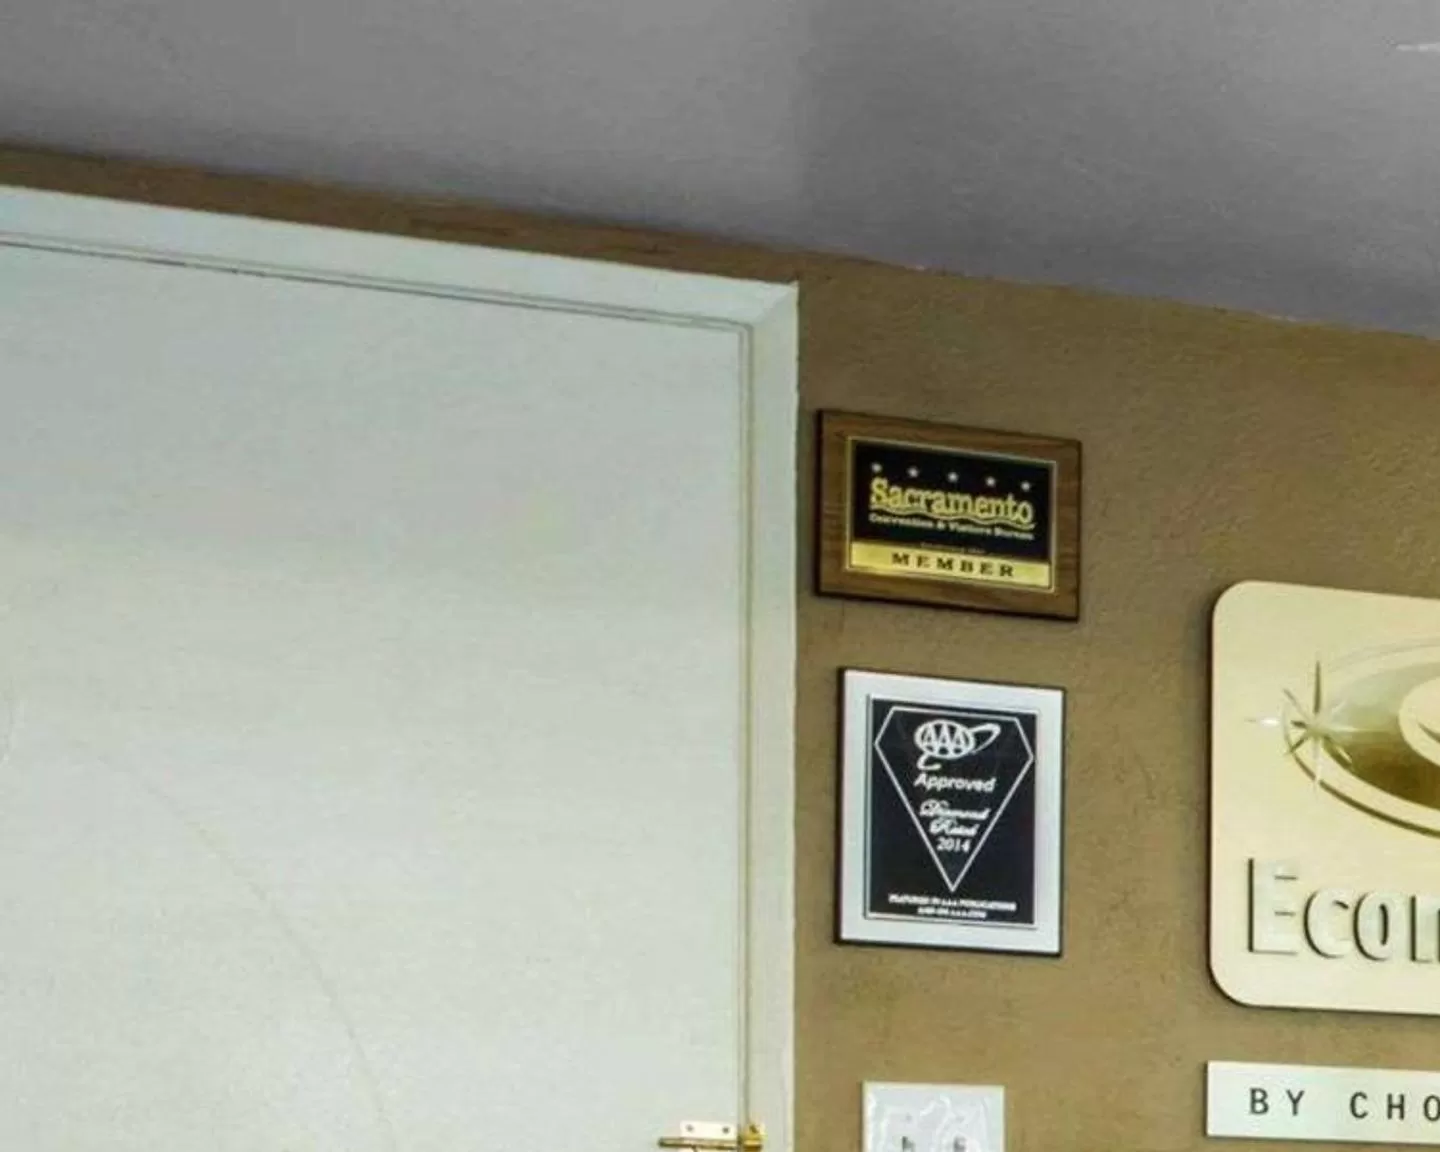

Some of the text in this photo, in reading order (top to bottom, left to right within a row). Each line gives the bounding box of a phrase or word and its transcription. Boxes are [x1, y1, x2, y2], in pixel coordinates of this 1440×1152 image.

[870, 477, 1034, 524] Sacramento
[892, 552, 1014, 577] MEMBER
[920, 720, 970, 750] AAA
[914, 773, 996, 793] Approved
[937, 837, 972, 852] 2014
[1250, 1088, 1304, 1116] BY
